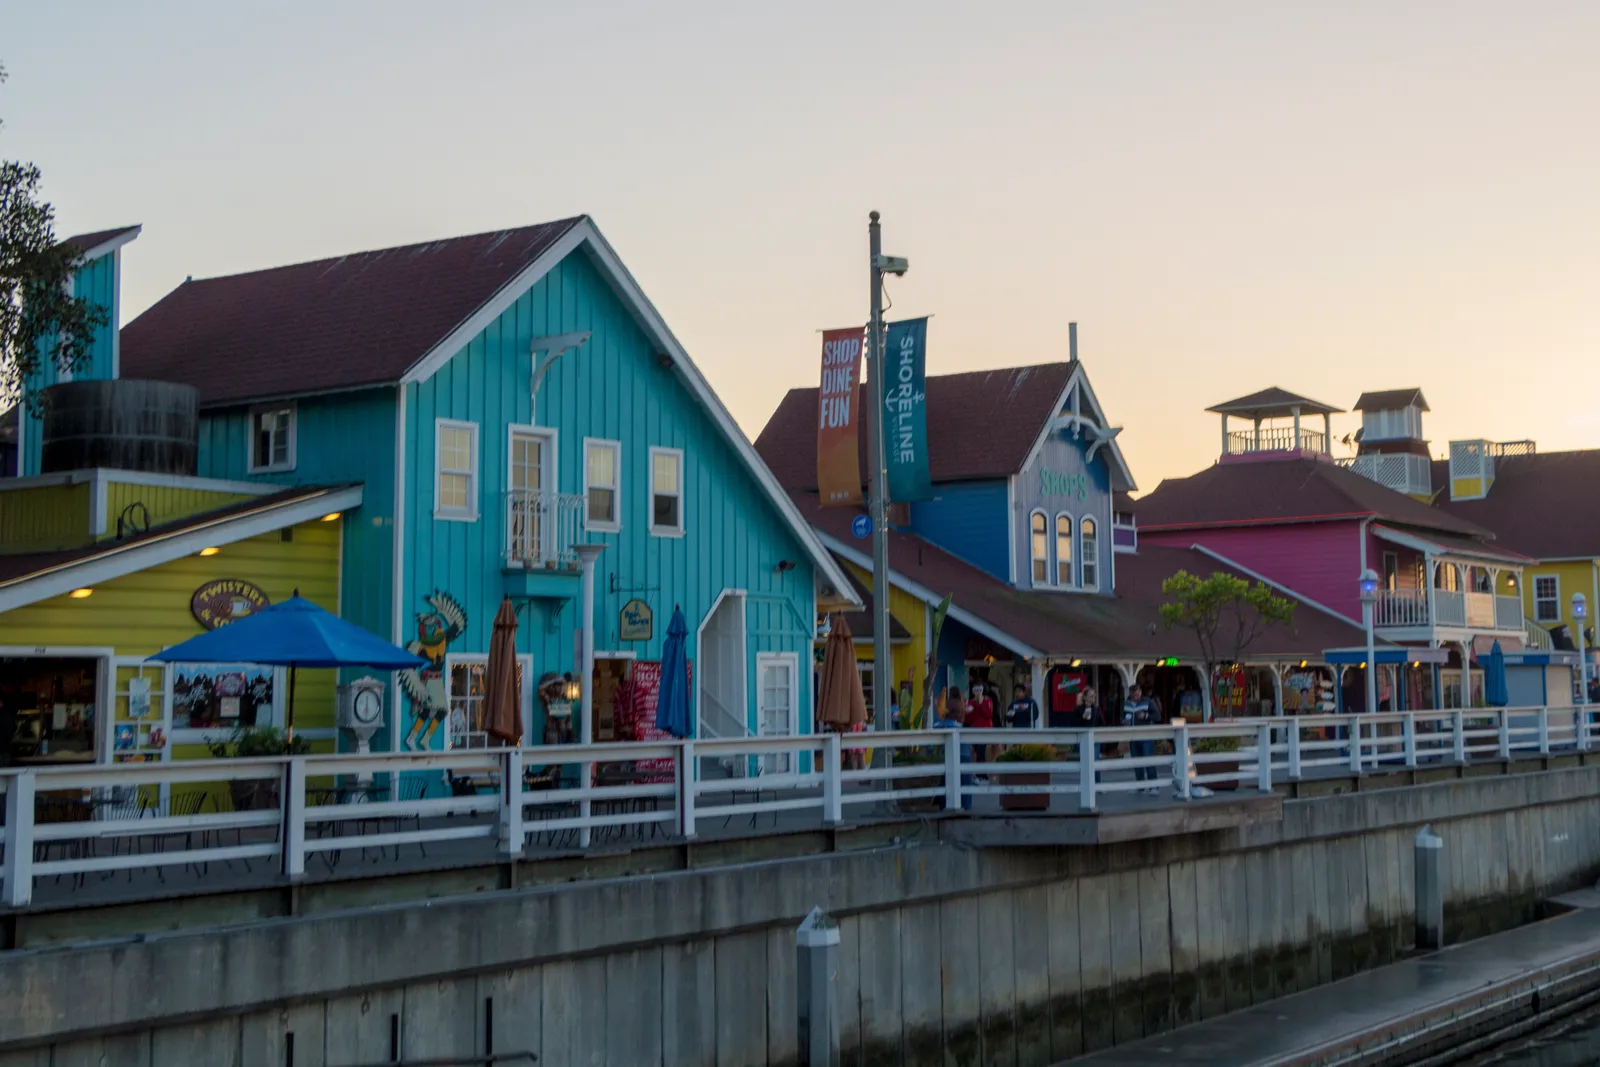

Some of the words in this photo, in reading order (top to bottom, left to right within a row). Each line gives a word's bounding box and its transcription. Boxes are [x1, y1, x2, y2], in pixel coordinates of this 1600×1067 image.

[824, 339, 859, 366] SHOP
[823, 367, 853, 394] DINE
[820, 396, 850, 429] FUN
[899, 337, 914, 463] SHORELINE
[1041, 467, 1088, 502] SHOPS
[200, 581, 264, 606] TWISTERS
